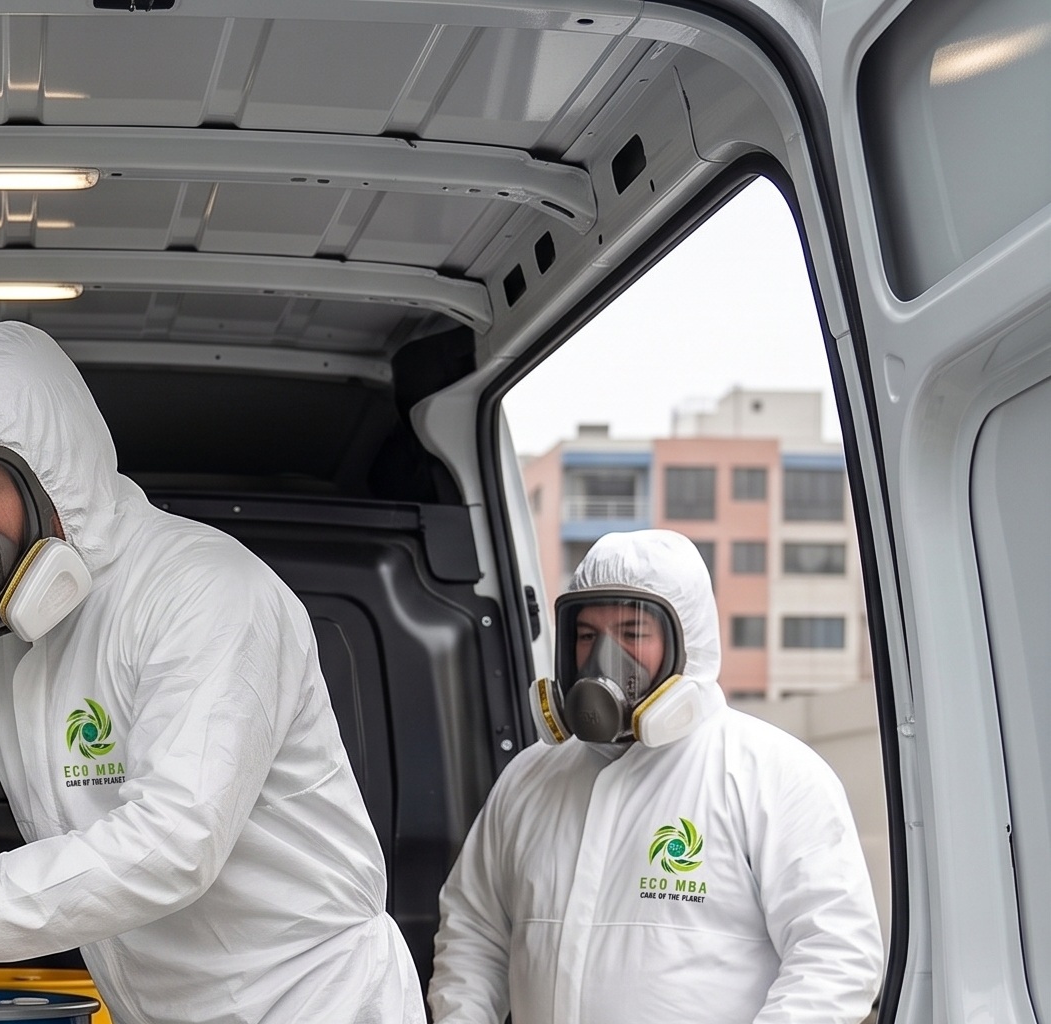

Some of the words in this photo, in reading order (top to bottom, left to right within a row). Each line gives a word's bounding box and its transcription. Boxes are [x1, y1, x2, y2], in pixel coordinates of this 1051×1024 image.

[63, 764, 89, 778] ECO
[96, 762, 125, 776] MBA
[639, 877, 668, 890] ECO
[675, 879, 707, 894] MBA
[668, 893, 680, 901] THE
